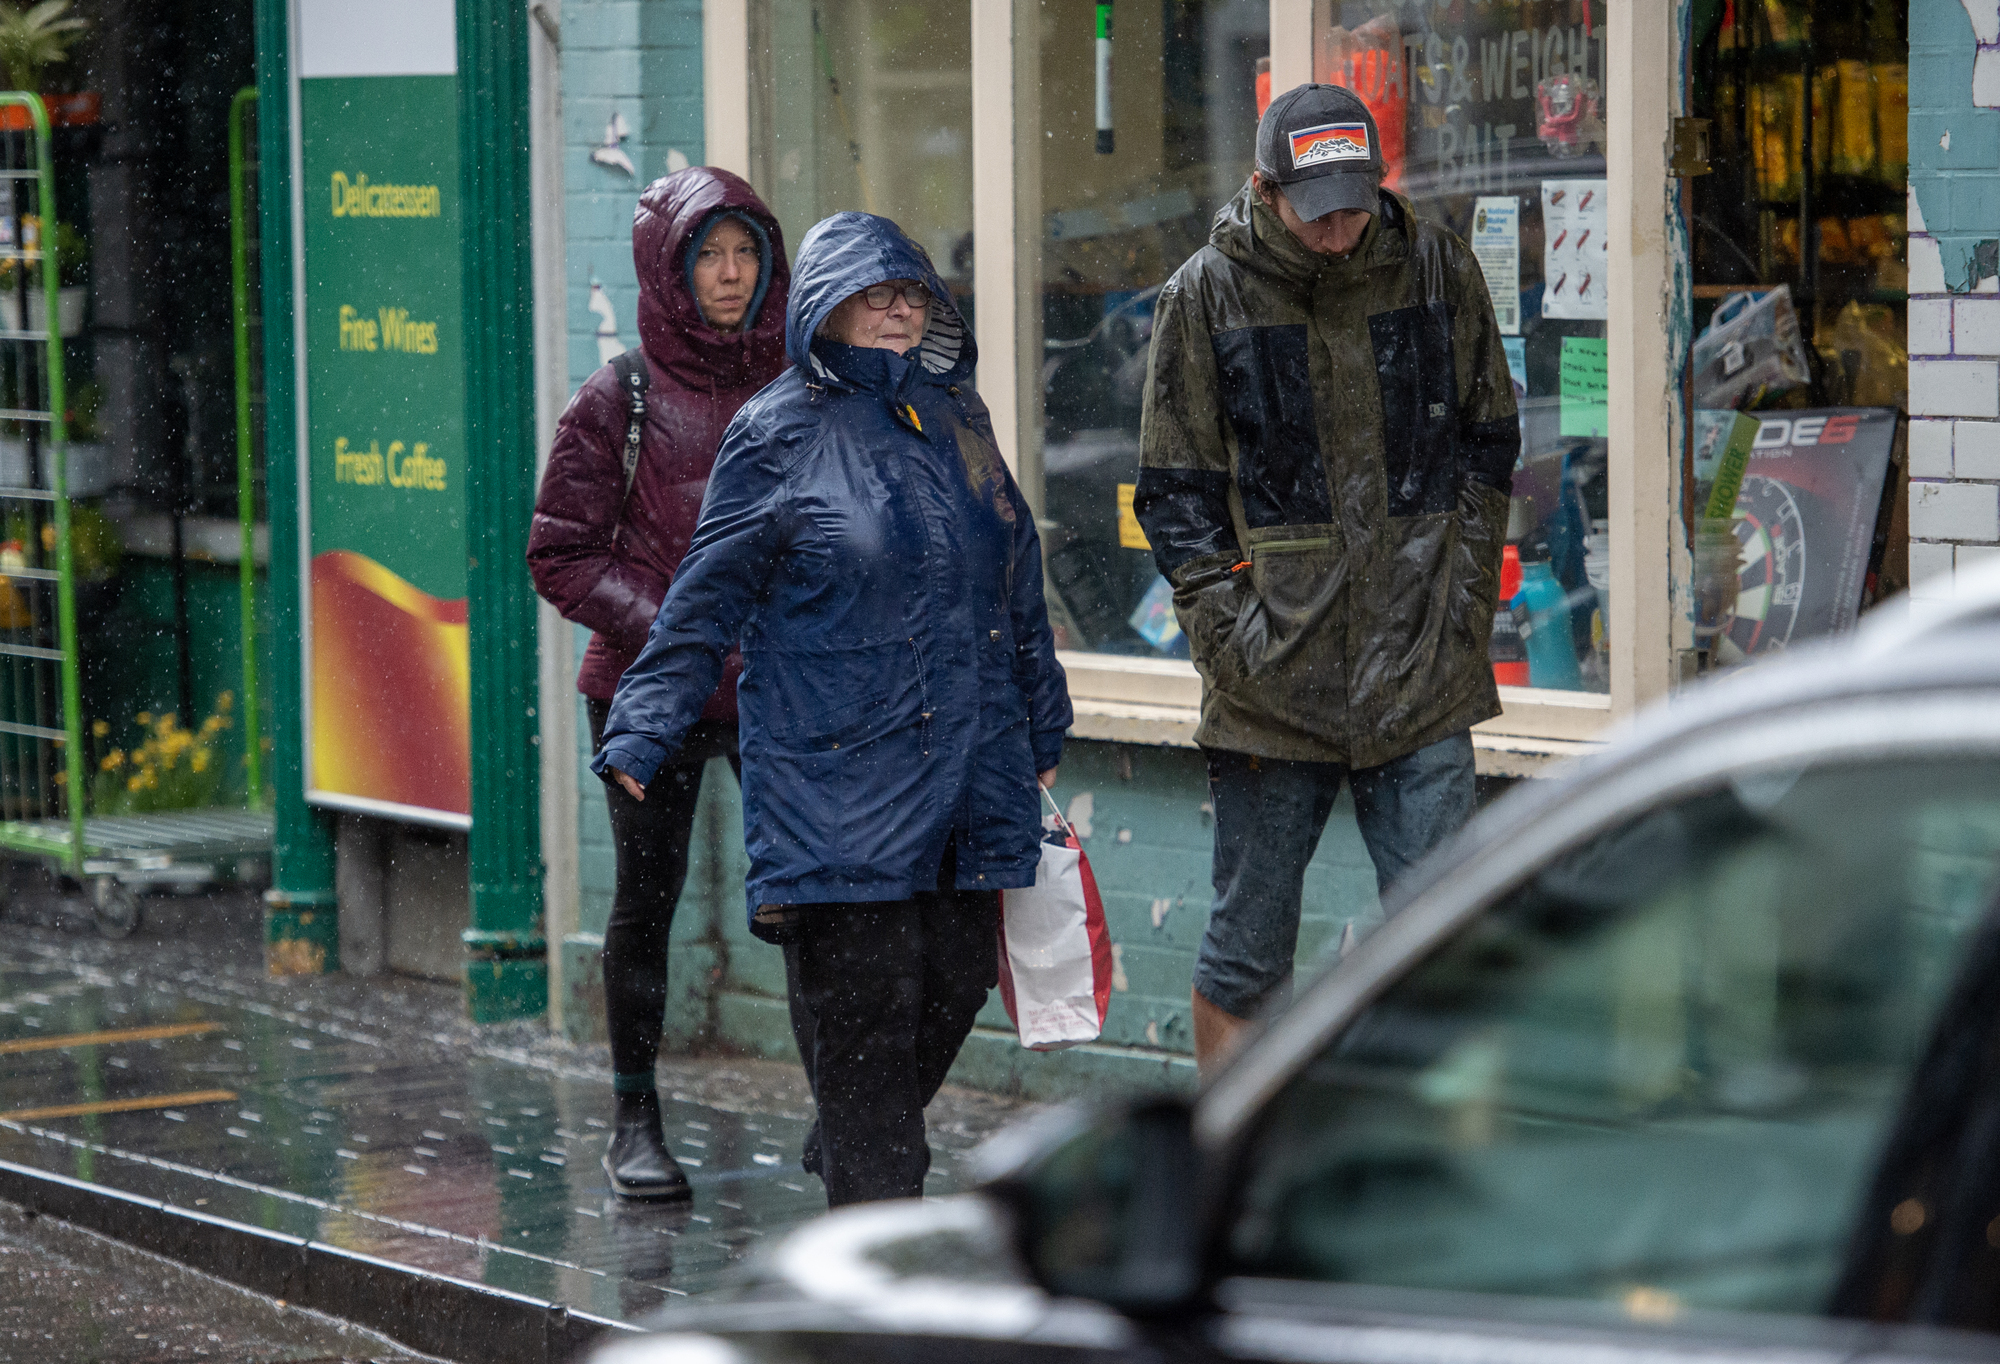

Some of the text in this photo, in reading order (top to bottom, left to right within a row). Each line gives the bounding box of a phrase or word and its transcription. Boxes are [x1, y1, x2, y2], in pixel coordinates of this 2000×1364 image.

[1437, 121, 1517, 196] BAIT
[331, 170, 440, 218] Delicatessen
[339, 304, 438, 355] Fine Wines
[335, 436, 447, 491] Fresh Coffee
